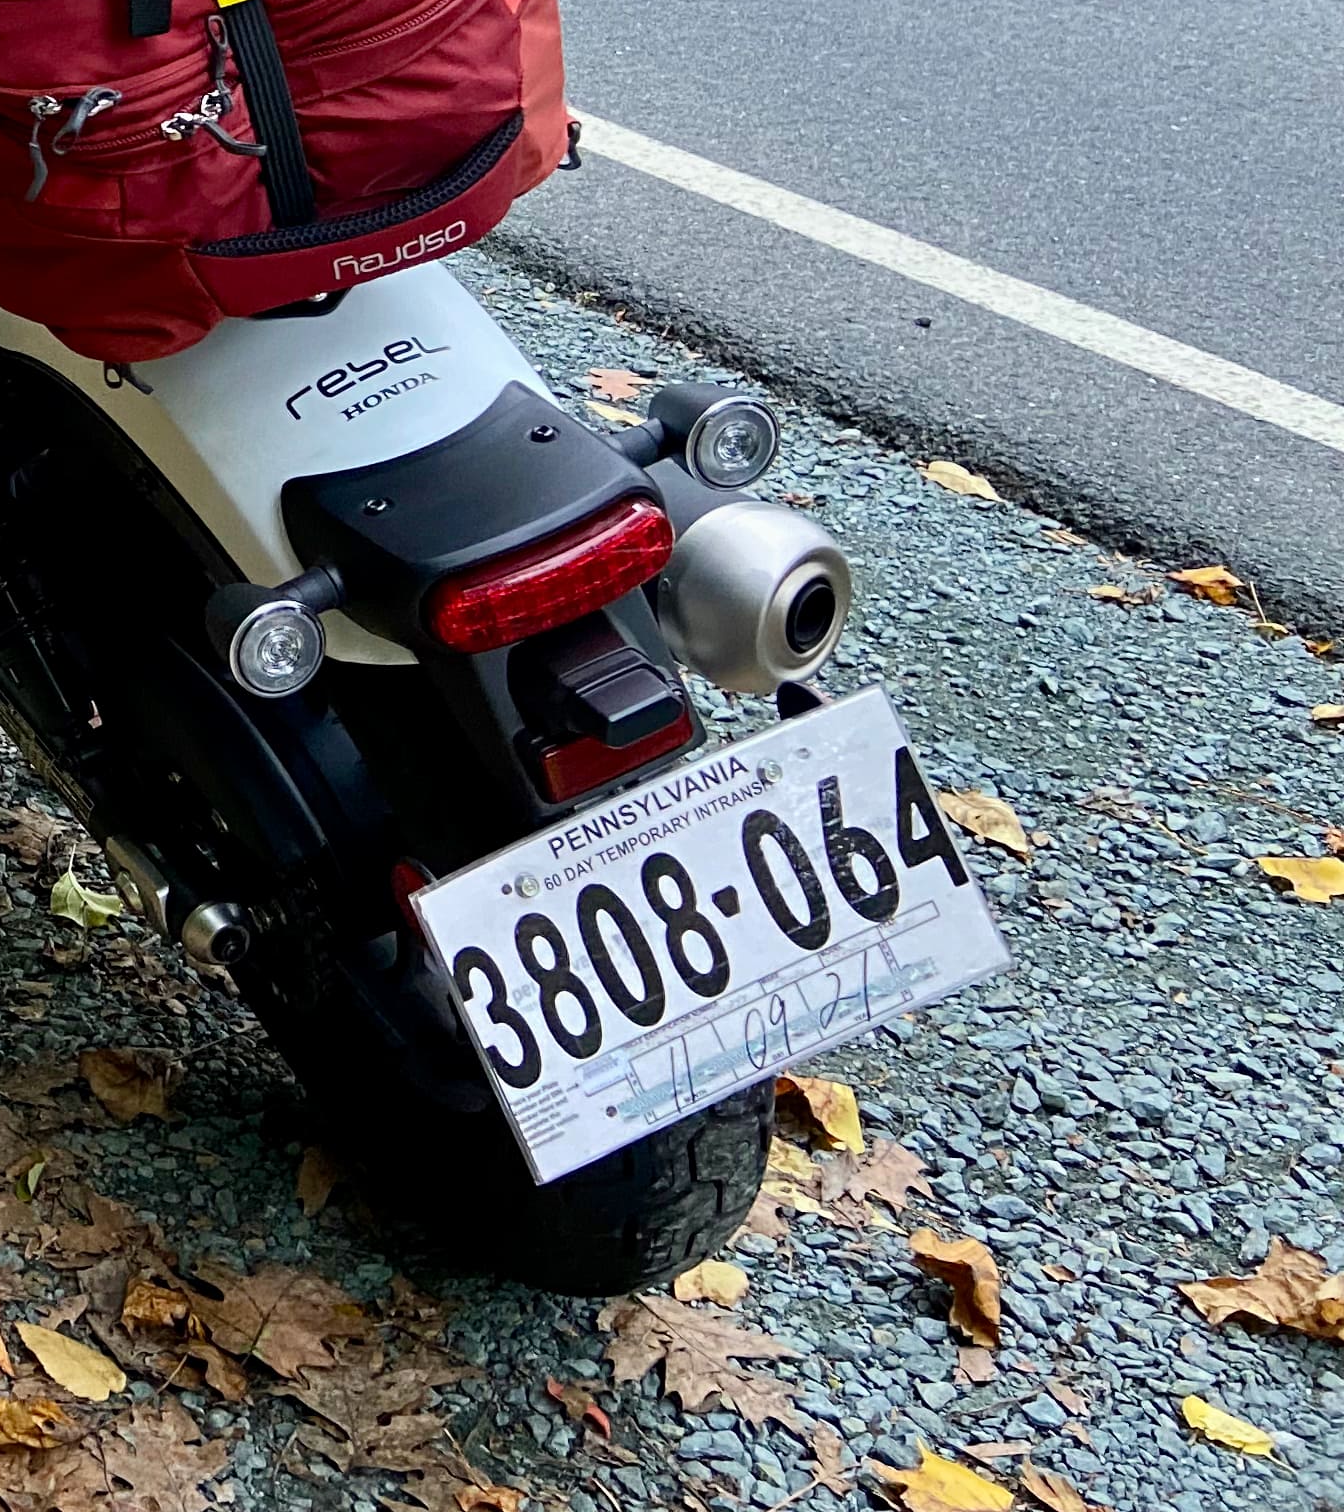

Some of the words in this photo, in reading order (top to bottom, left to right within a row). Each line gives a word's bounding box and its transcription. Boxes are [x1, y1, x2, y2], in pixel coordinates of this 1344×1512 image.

[340, 372, 440, 422] HONDA
[543, 876, 562, 891] 60
[563, 855, 595, 882] DAY
[596, 810, 692, 866] TEMPORARY
[548, 755, 749, 860] PENNSYLVANIA
[452, 745, 969, 1089] 3808-064
